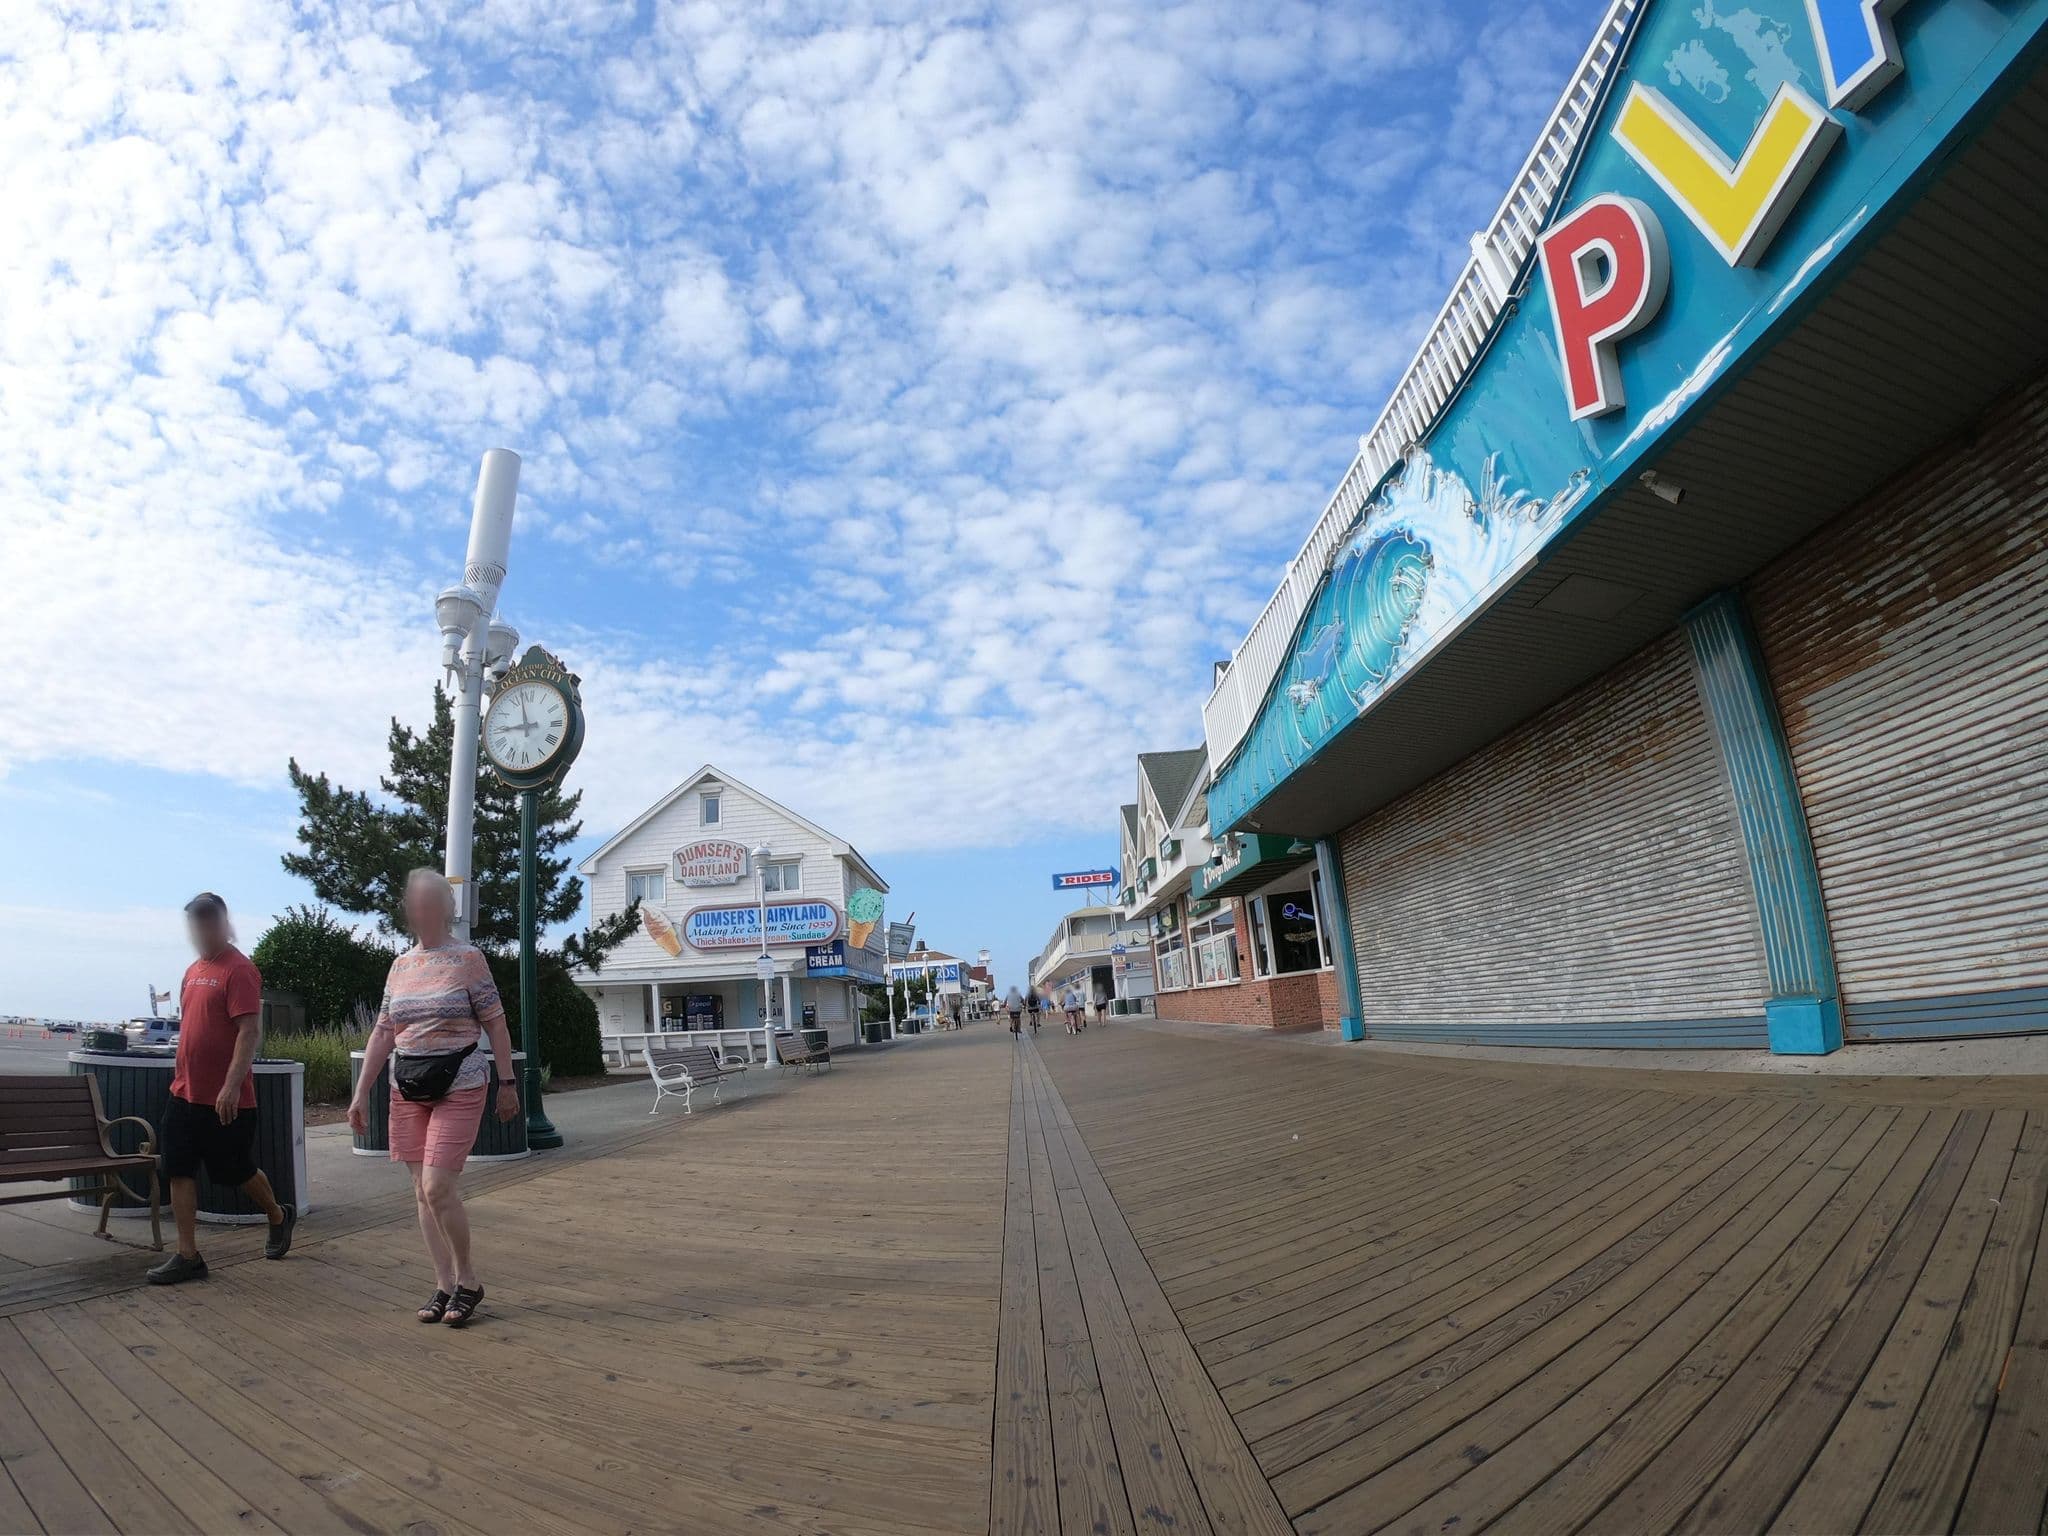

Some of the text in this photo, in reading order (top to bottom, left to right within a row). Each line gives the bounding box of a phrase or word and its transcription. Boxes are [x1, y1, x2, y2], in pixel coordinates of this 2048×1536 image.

[501, 669, 564, 690] OCEAN CITY
[677, 843, 743, 865] DUMSER'S
[681, 862, 739, 877] DAIRYLAND
[1065, 874, 1111, 884] RIDES
[695, 909, 755, 927] DUMSER'S
[689, 927, 728, 938] Making
[731, 926, 745, 935] Ice
[781, 923, 806, 931] Since
[808, 921, 833, 930] 1939
[696, 937, 717, 946] Thick
[791, 931, 826, 940] Sundaes
[817, 943, 834, 954] ICE
[809, 954, 843, 967] CREAM
[759, 1007, 783, 1018] CRAM
